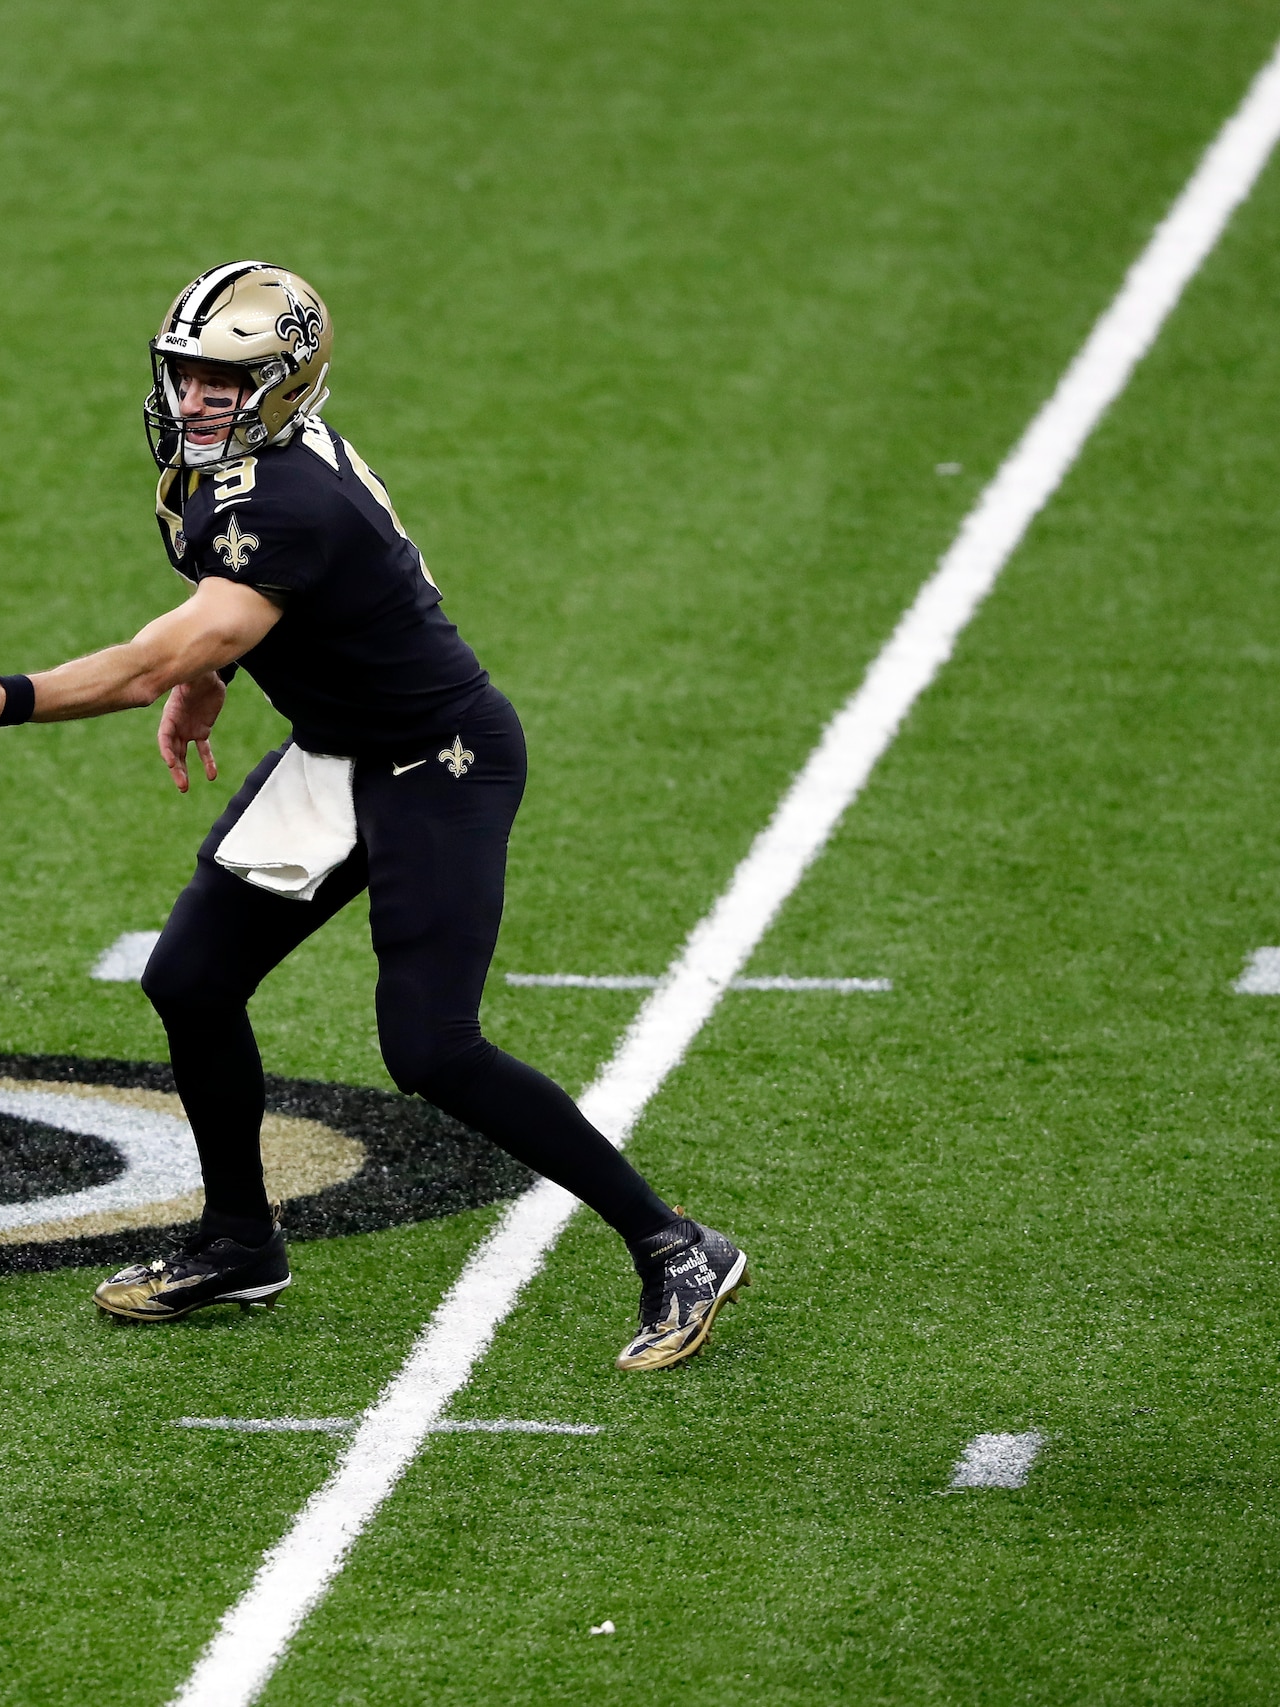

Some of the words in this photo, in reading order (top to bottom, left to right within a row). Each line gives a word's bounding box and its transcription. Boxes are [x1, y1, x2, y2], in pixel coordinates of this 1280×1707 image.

[165, 335, 187, 348] SAINTS
[214, 456, 258, 500] 9
[668, 1251, 708, 1277] Football
[694, 1269, 717, 1286] Faith
